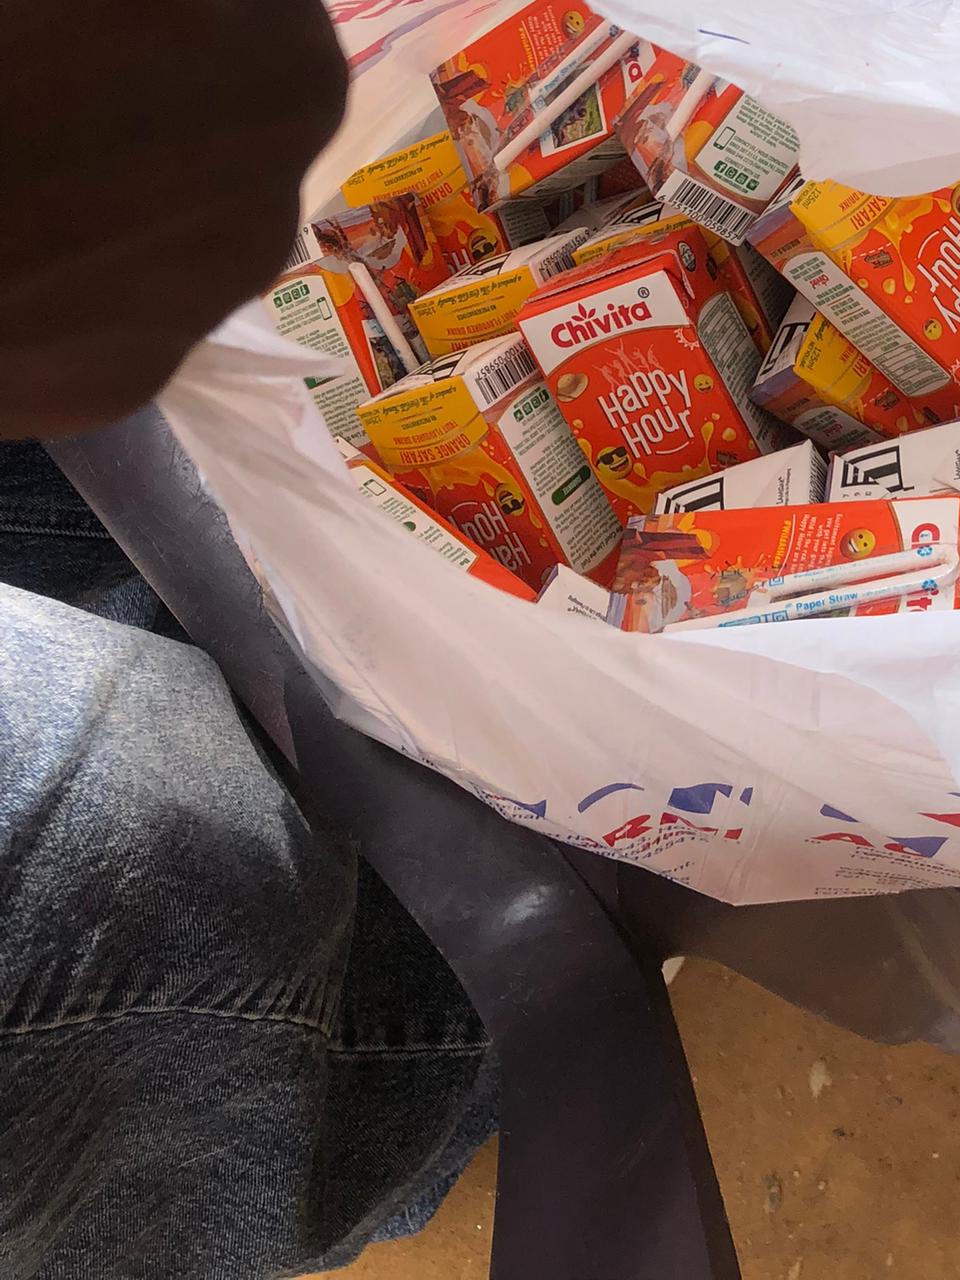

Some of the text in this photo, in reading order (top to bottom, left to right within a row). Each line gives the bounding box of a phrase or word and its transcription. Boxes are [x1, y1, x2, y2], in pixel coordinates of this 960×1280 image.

[657, 194, 666, 202] 6
[702, 219, 741, 242] 059857
[802, 187, 822, 210] 125ml
[852, 195, 889, 232] SAFARI
[550, 302, 653, 349] Chivita
[597, 368, 693, 430] Happy
[400, 432, 472, 465] ORANGE SAFARI
[619, 404, 696, 460] Hour
[795, 590, 859, 614] Paper Straw
